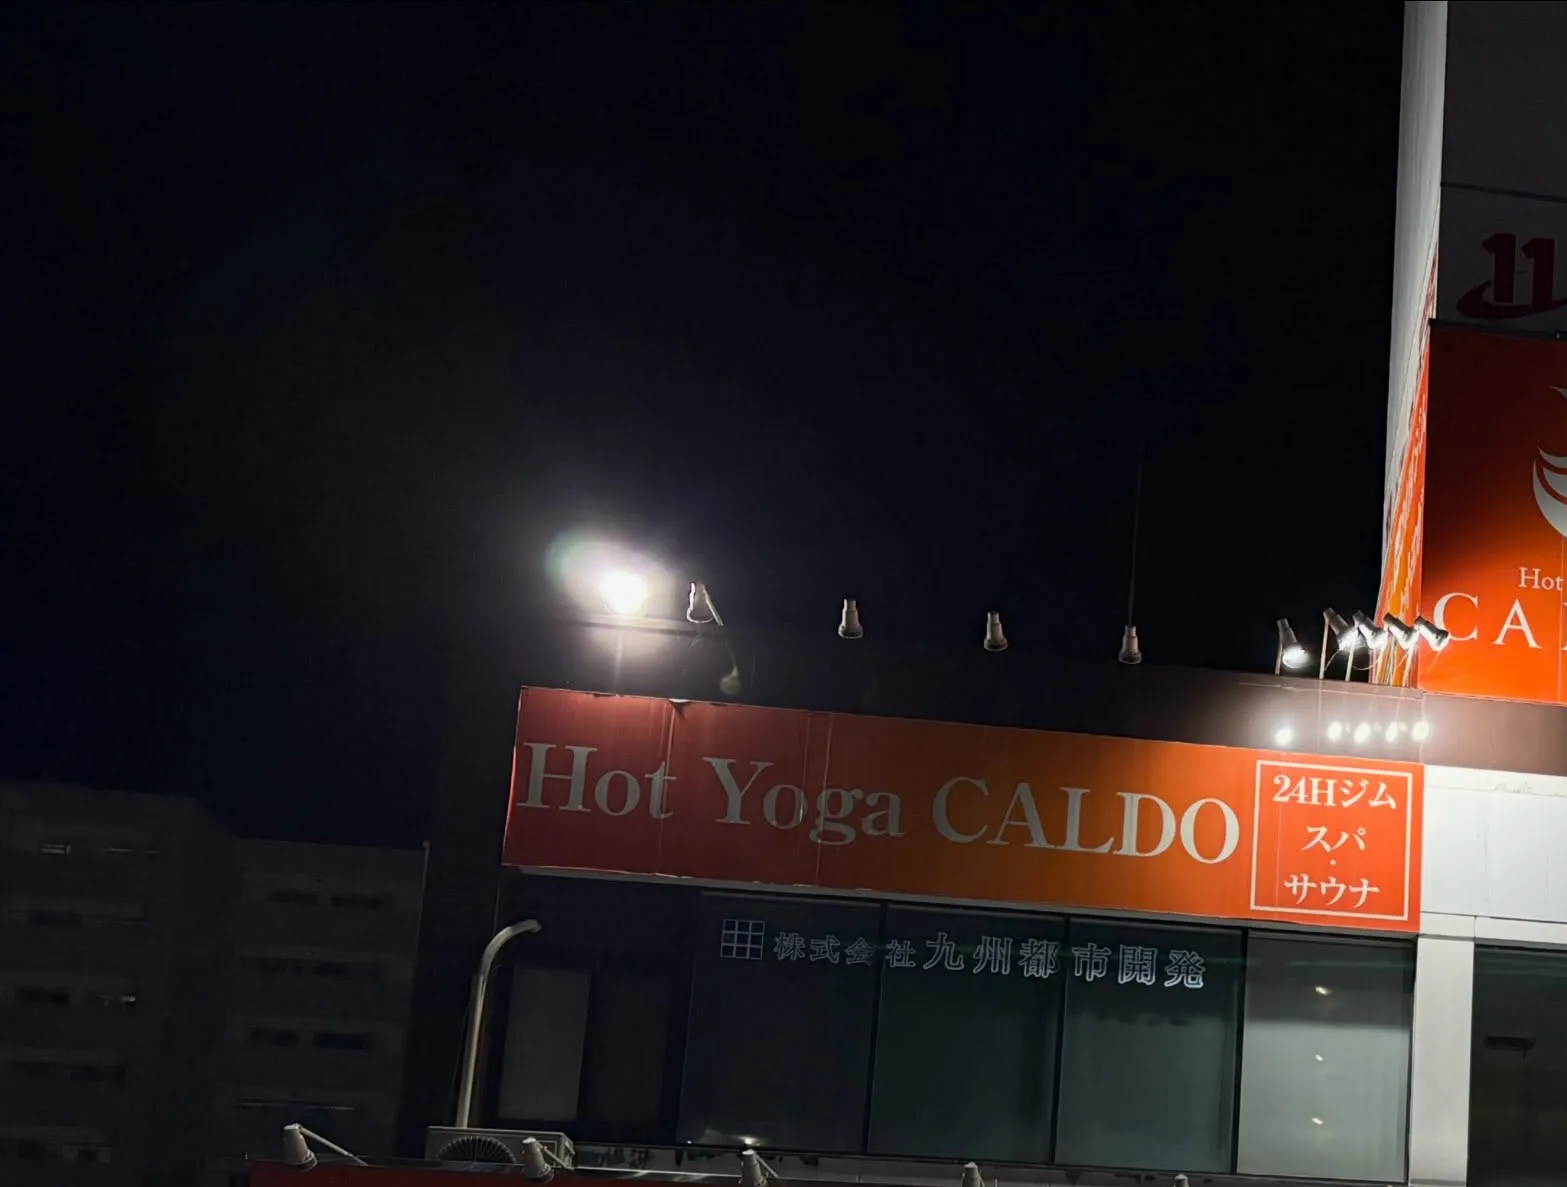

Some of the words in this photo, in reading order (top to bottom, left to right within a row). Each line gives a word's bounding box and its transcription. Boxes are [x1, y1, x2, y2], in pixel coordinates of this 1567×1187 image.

[1519, 568, 1564, 592] Hot
[516, 741, 679, 820] Hot
[704, 758, 904, 845] Yoga
[932, 777, 1240, 865] CALDO
[1272, 771, 1397, 810] 24Hジム
[1302, 824, 1366, 852] スパ
[1283, 874, 1380, 909] サウナ
[774, 931, 1206, 989] 株式会社九州都市開発
